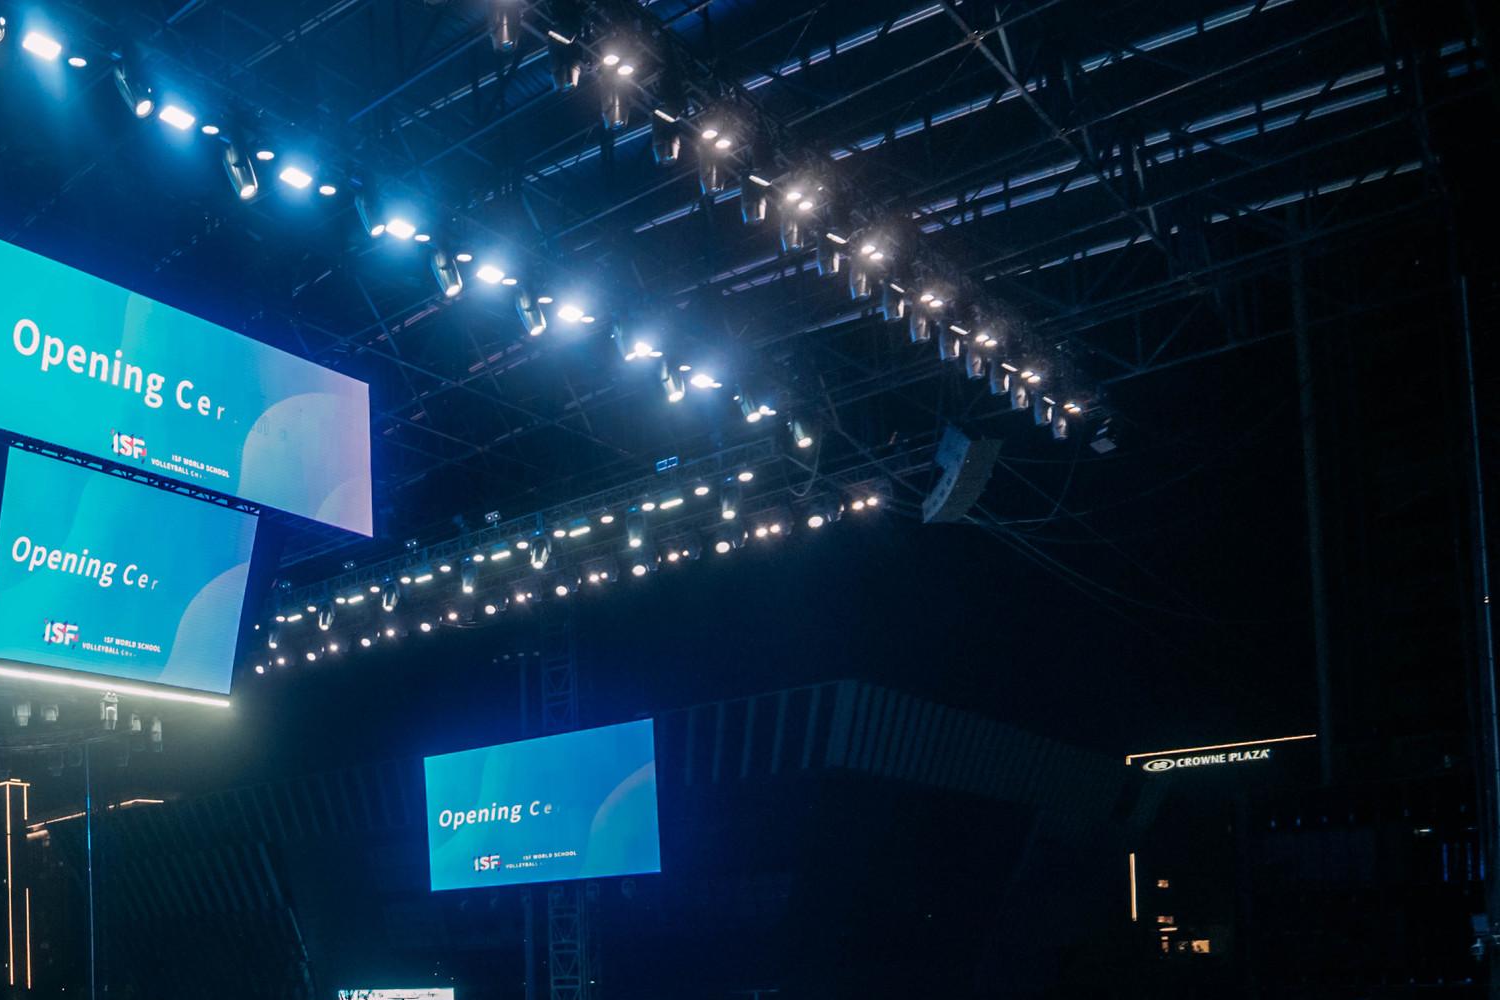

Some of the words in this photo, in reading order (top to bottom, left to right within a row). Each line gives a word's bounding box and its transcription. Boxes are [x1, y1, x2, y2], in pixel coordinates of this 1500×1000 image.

[12, 318, 166, 409] Opening
[113, 432, 147, 461] ISF
[151, 457, 189, 476] VOLLEYBALL
[11, 535, 117, 588] Opening
[44, 621, 79, 646] ISF
[82, 641, 120, 655] VOLLEYBALL
[138, 641, 161, 653] SCHOOL
[1175, 754, 1227, 768] CROWNE
[1228, 750, 1269, 762] PLAZA
[438, 802, 522, 831] Opening
[473, 854, 500, 872] ISF
